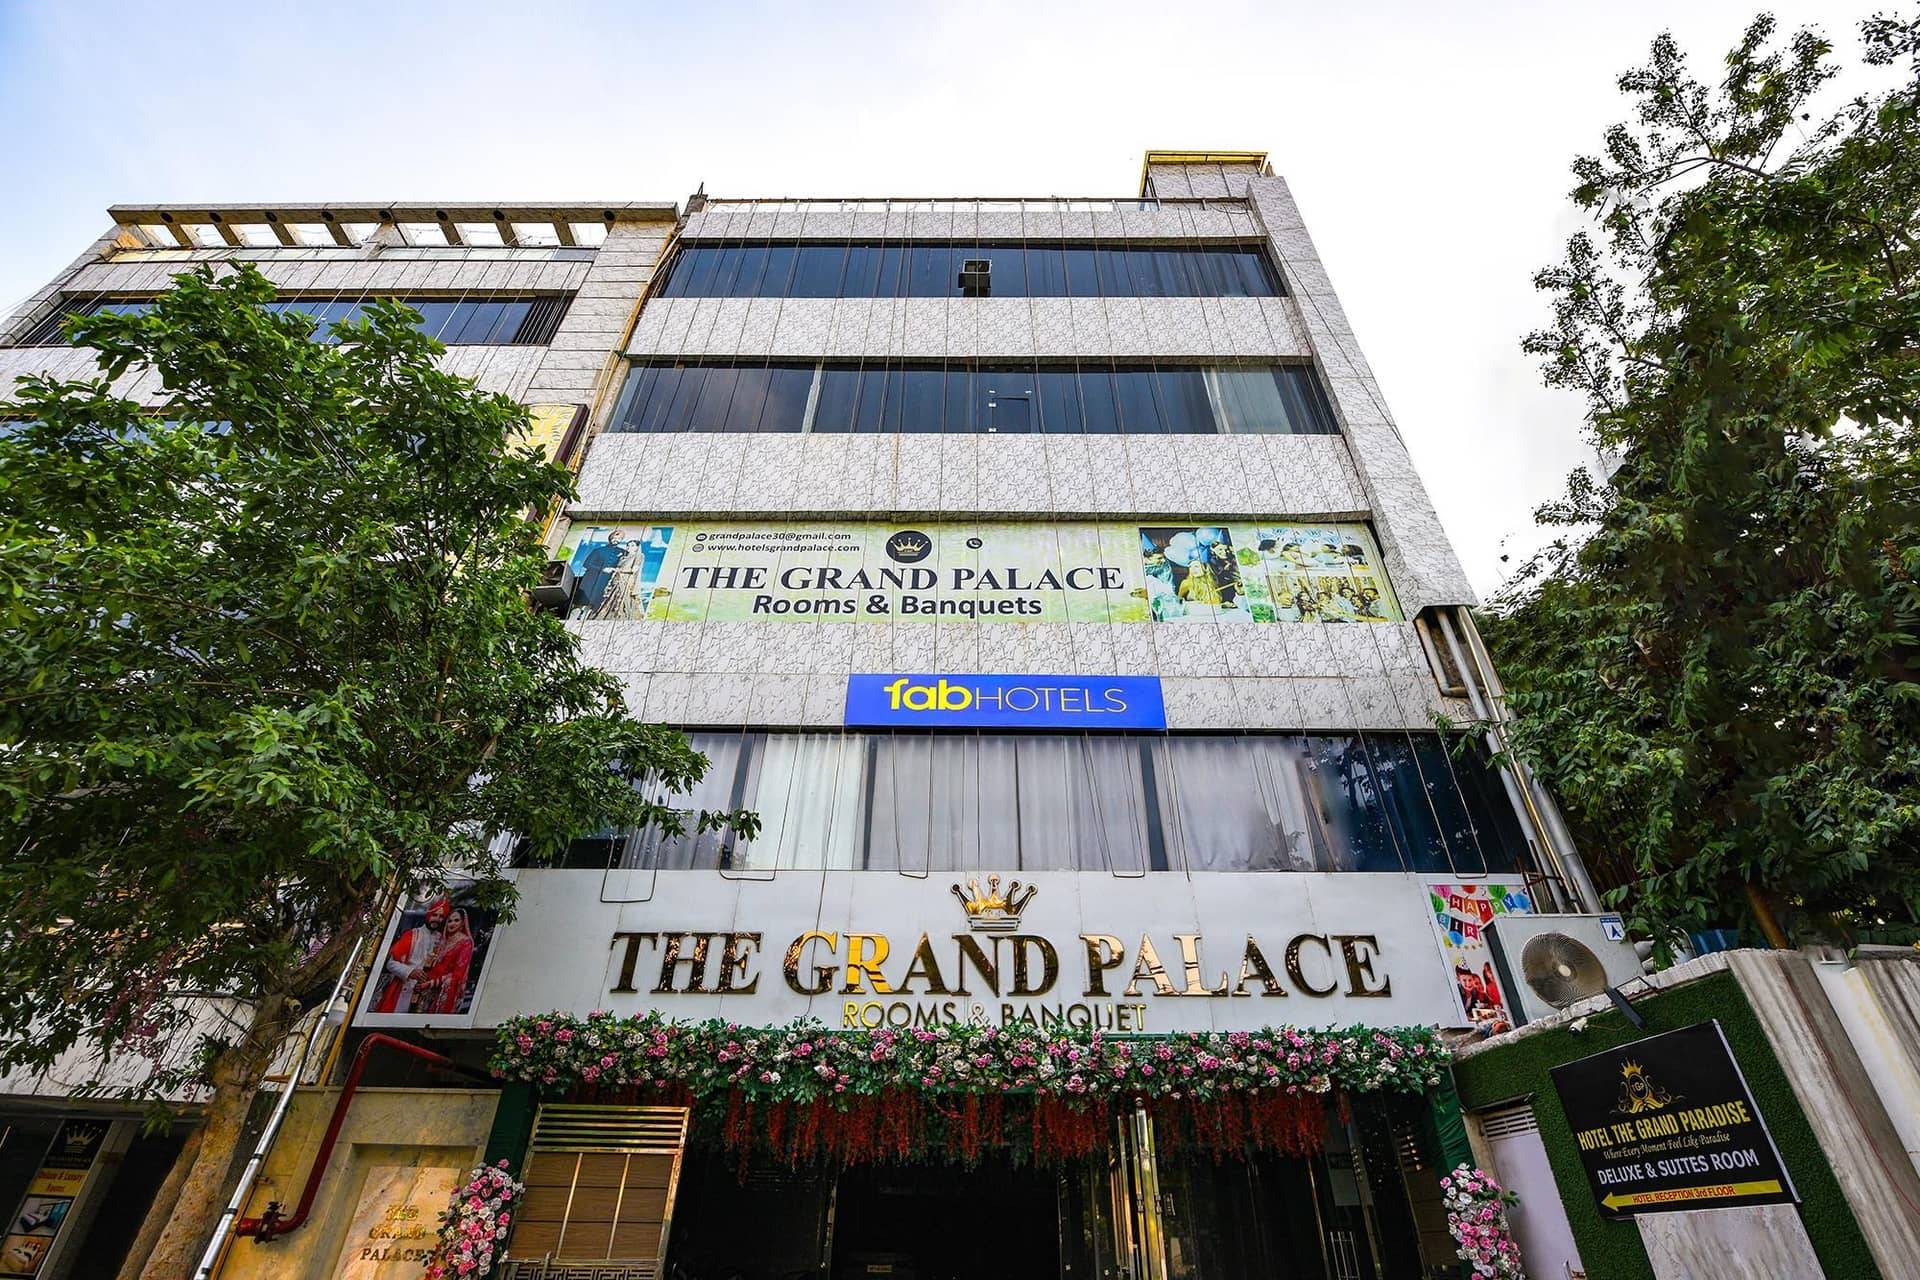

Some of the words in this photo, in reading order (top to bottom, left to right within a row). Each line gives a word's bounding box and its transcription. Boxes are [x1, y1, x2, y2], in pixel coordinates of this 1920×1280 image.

[707, 543, 861, 553] www.hotelsgrandpalace.com
[708, 532, 851, 542] grandpalace30@gmail.com
[682, 567, 768, 590] THE
[780, 567, 938, 590] GRAND
[951, 567, 1125, 590] PALACE
[752, 595, 857, 614] Rooms
[865, 594, 890, 615] &
[901, 595, 1042, 618] Banquets
[883, 678, 1128, 713] fabHOTELS
[610, 931, 765, 995] THE
[782, 930, 1060, 997] GRAND
[1078, 932, 1393, 998] PALACE
[842, 1001, 956, 1029] ROOMS
[969, 1003, 991, 1028] &
[1001, 1002, 1147, 1032] BANQUET
[1577, 1127, 1613, 1151] HOTEL
[1611, 1122, 1637, 1145] THE
[1636, 1114, 1680, 1140] GRAND
[1679, 1100, 1751, 1132] PARADISE
[1699, 1130, 1730, 1146] Paradise
[1597, 1164, 1645, 1185] DELUXE
[1645, 1162, 1658, 1179] &
[1657, 1155, 1710, 1177] SUITES
[1710, 1149, 1760, 1171] ROOM
[1632, 1194, 1654, 1204] HOTEL
[1655, 1189, 1694, 1201] RECEPTION
[1708, 1186, 1735, 1197] FLOOR
[360, 1247, 425, 1262] PALACE
